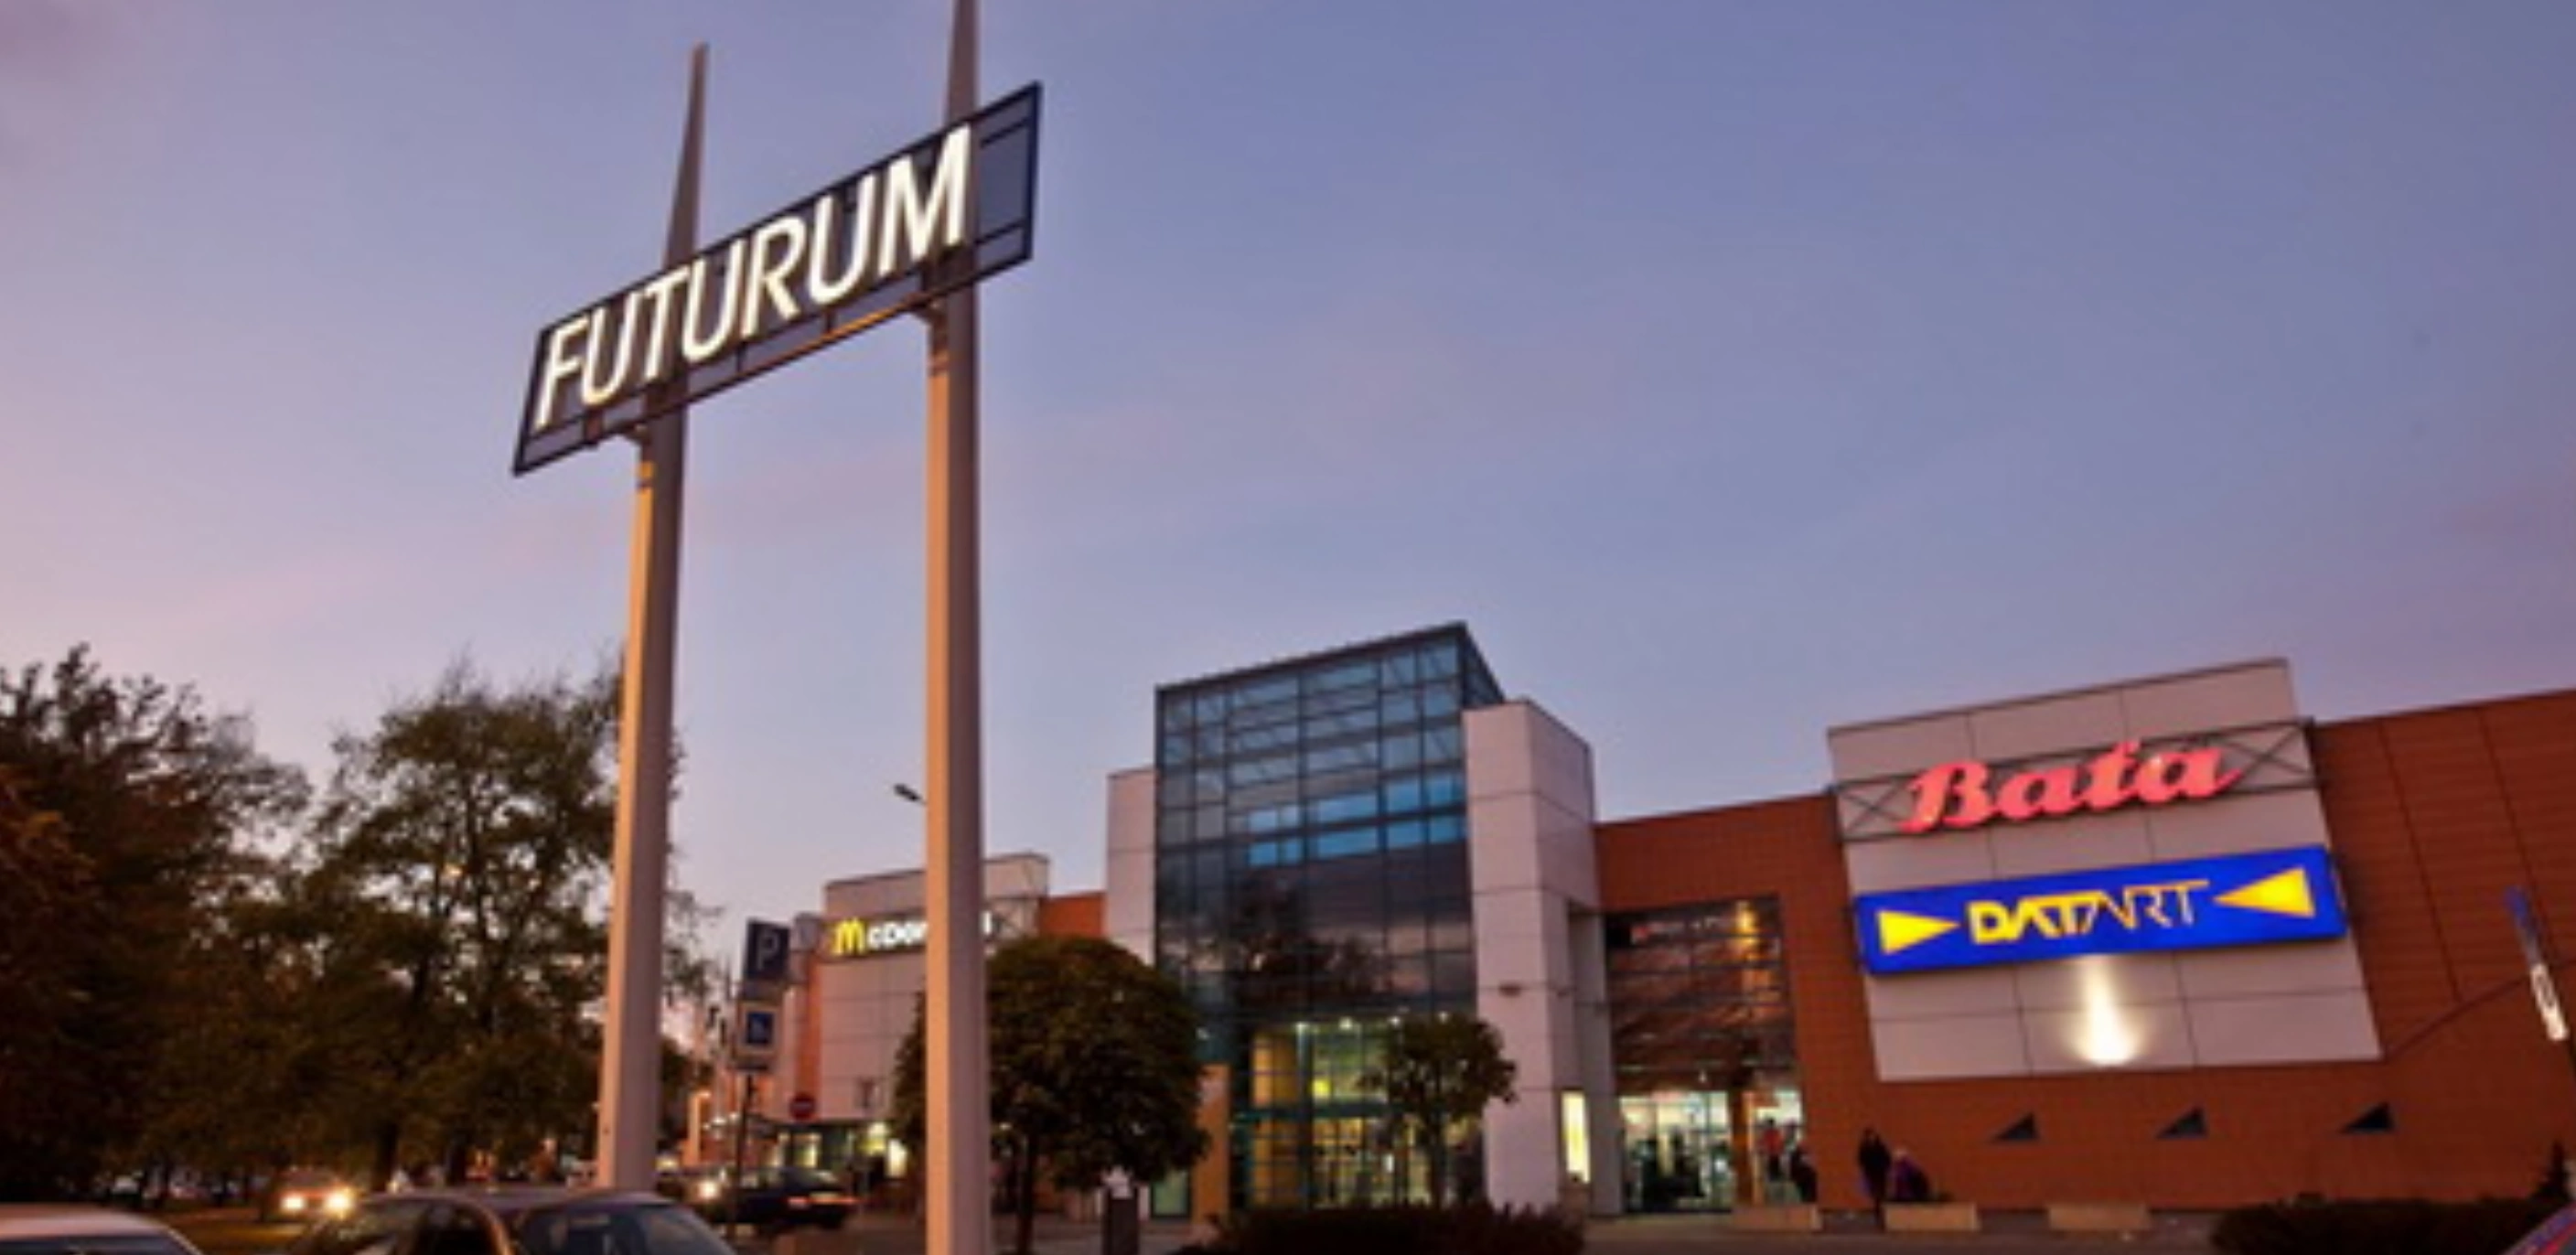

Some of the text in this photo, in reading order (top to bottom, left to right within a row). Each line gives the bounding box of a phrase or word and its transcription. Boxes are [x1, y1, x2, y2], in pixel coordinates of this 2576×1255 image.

[534, 123, 972, 430] FUTURUM
[1896, 740, 2243, 832] Bata
[757, 929, 780, 971] P
[1968, 879, 2210, 943] DATART
